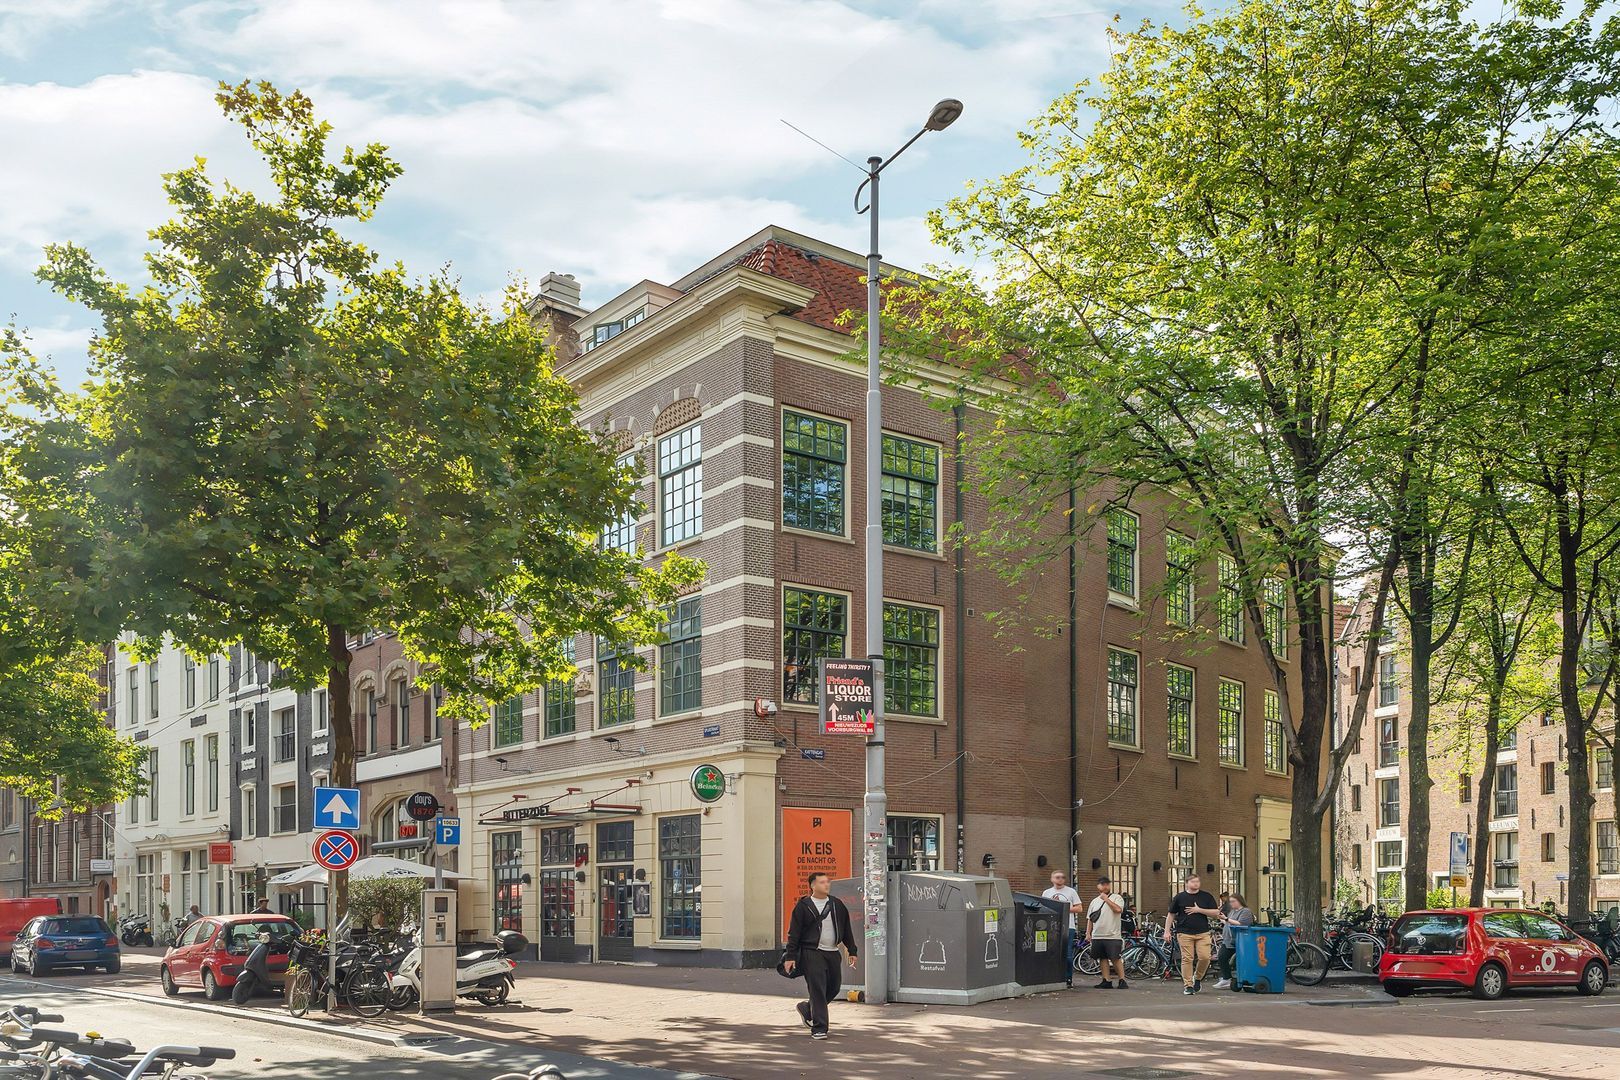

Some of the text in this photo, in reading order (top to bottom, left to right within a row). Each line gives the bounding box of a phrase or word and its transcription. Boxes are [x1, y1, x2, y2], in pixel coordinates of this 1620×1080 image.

[826, 676, 864, 685] Friend's
[826, 685, 871, 695] LIQUOR
[697, 782, 723, 791] Heineken
[413, 807, 434, 816] 1870
[502, 804, 550, 821] BITTERZOET
[443, 827, 453, 842] P
[801, 842, 832, 855] IK EIS
[920, 964, 946, 972] Restafval
